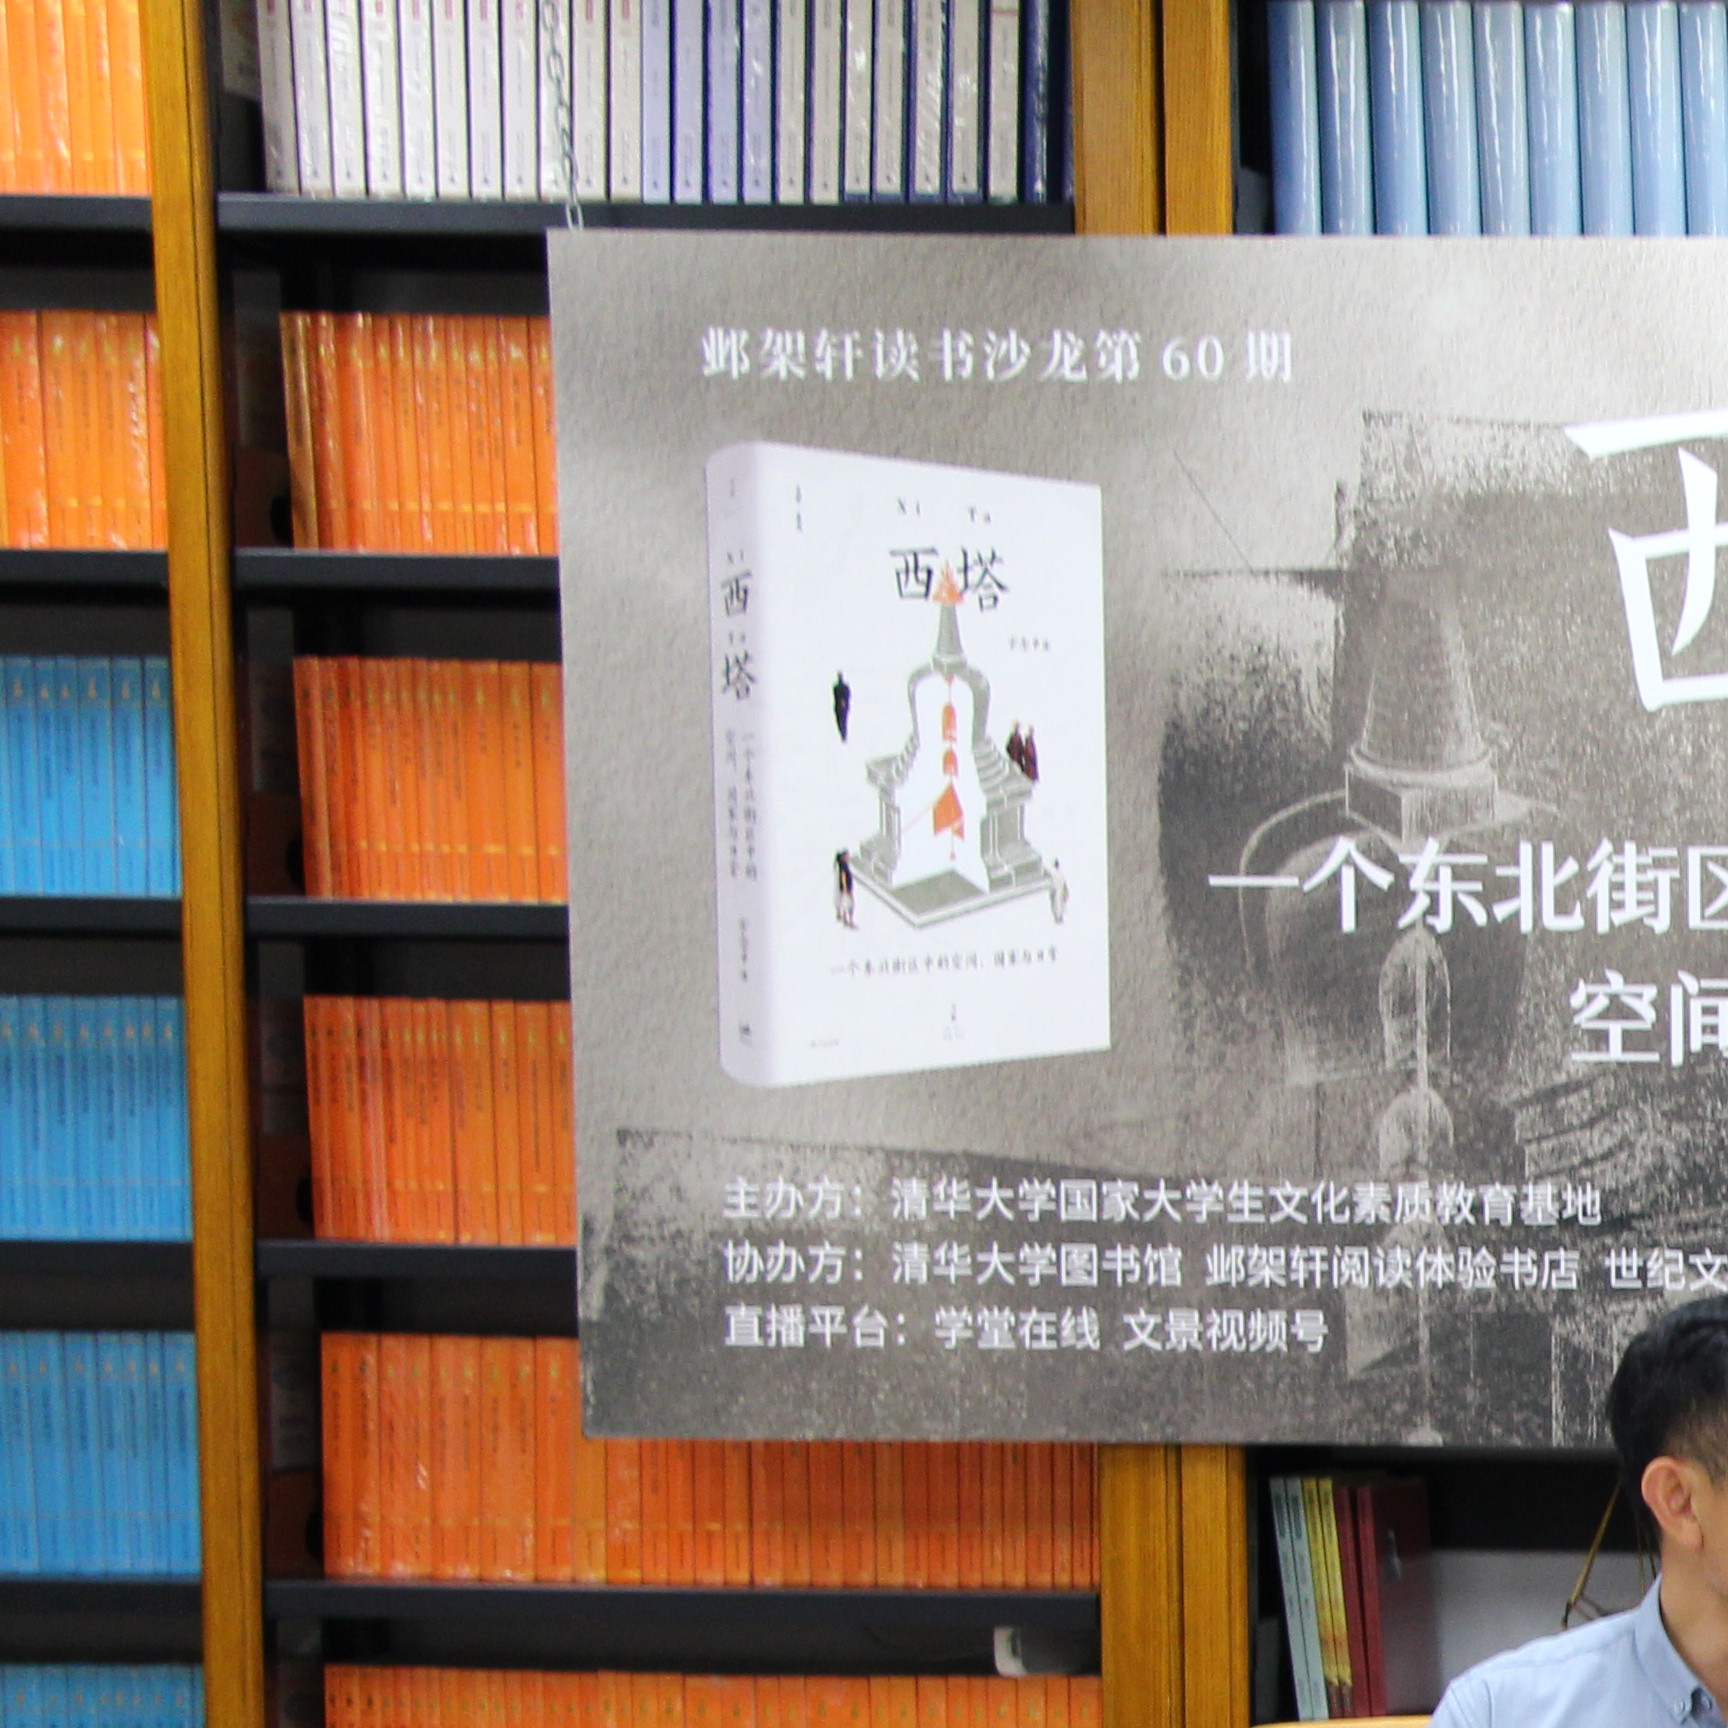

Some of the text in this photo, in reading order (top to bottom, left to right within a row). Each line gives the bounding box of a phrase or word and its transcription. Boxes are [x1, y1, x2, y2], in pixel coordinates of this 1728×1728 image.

[889, 546, 1010, 613] 西塔
[1205, 1241, 1581, 1293] 邺架轩阅读体验书店
[1122, 1306, 1331, 1354] 文景视频号
